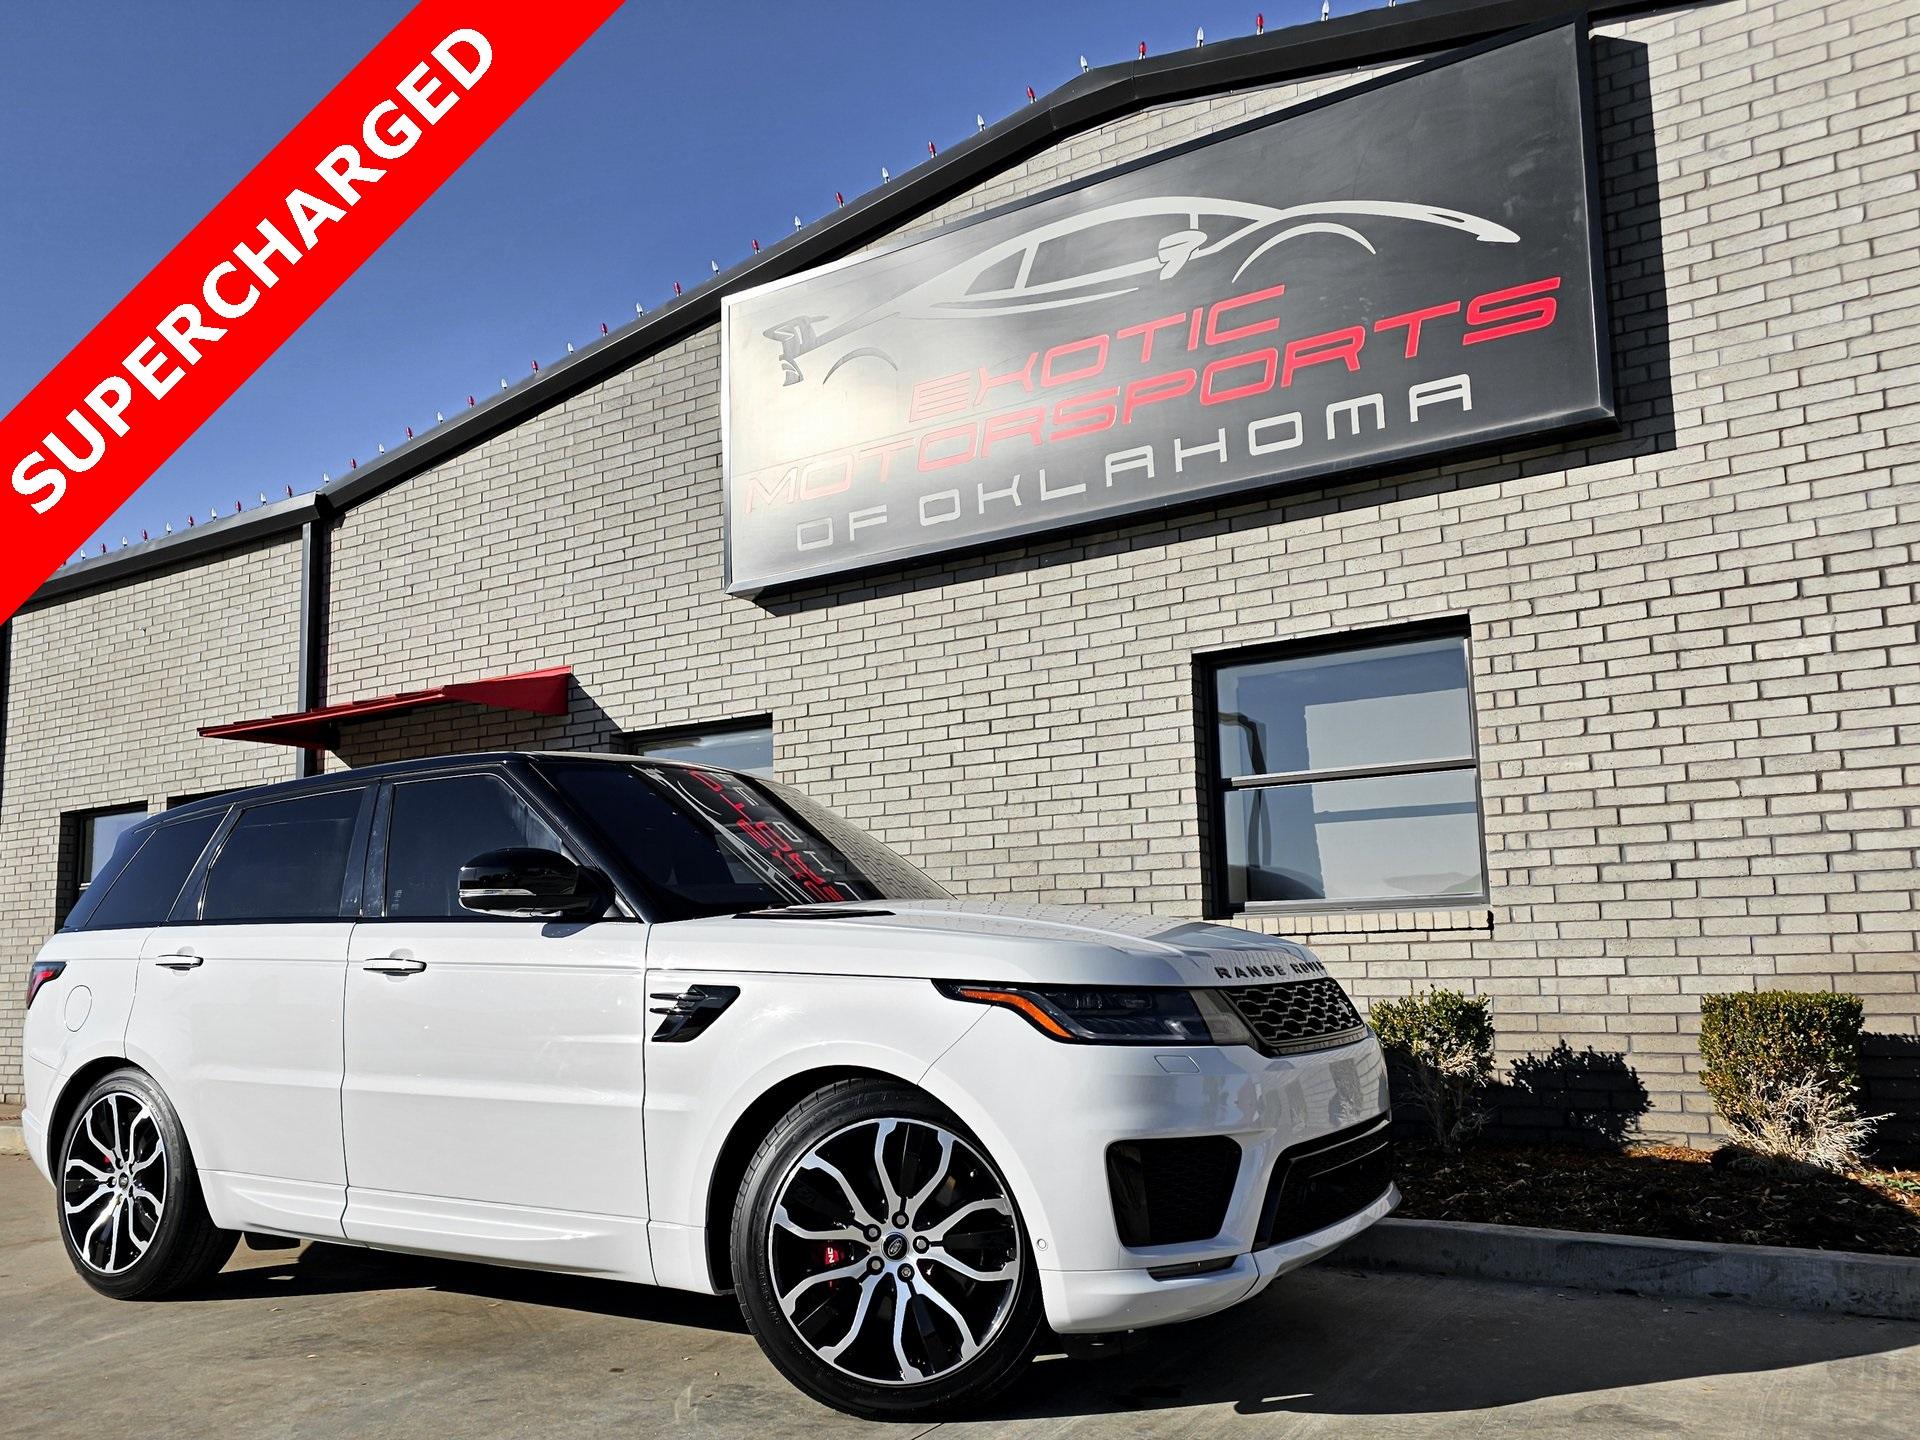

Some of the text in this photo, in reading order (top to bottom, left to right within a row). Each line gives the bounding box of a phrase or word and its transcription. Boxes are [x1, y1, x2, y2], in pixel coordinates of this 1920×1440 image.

[745, 276, 1562, 515] MOTORSPORTS
[908, 284, 1287, 423] EXOTIC
[796, 373, 1472, 551] OF OKLAHOMA
[1214, 965, 1286, 979] RANGE
